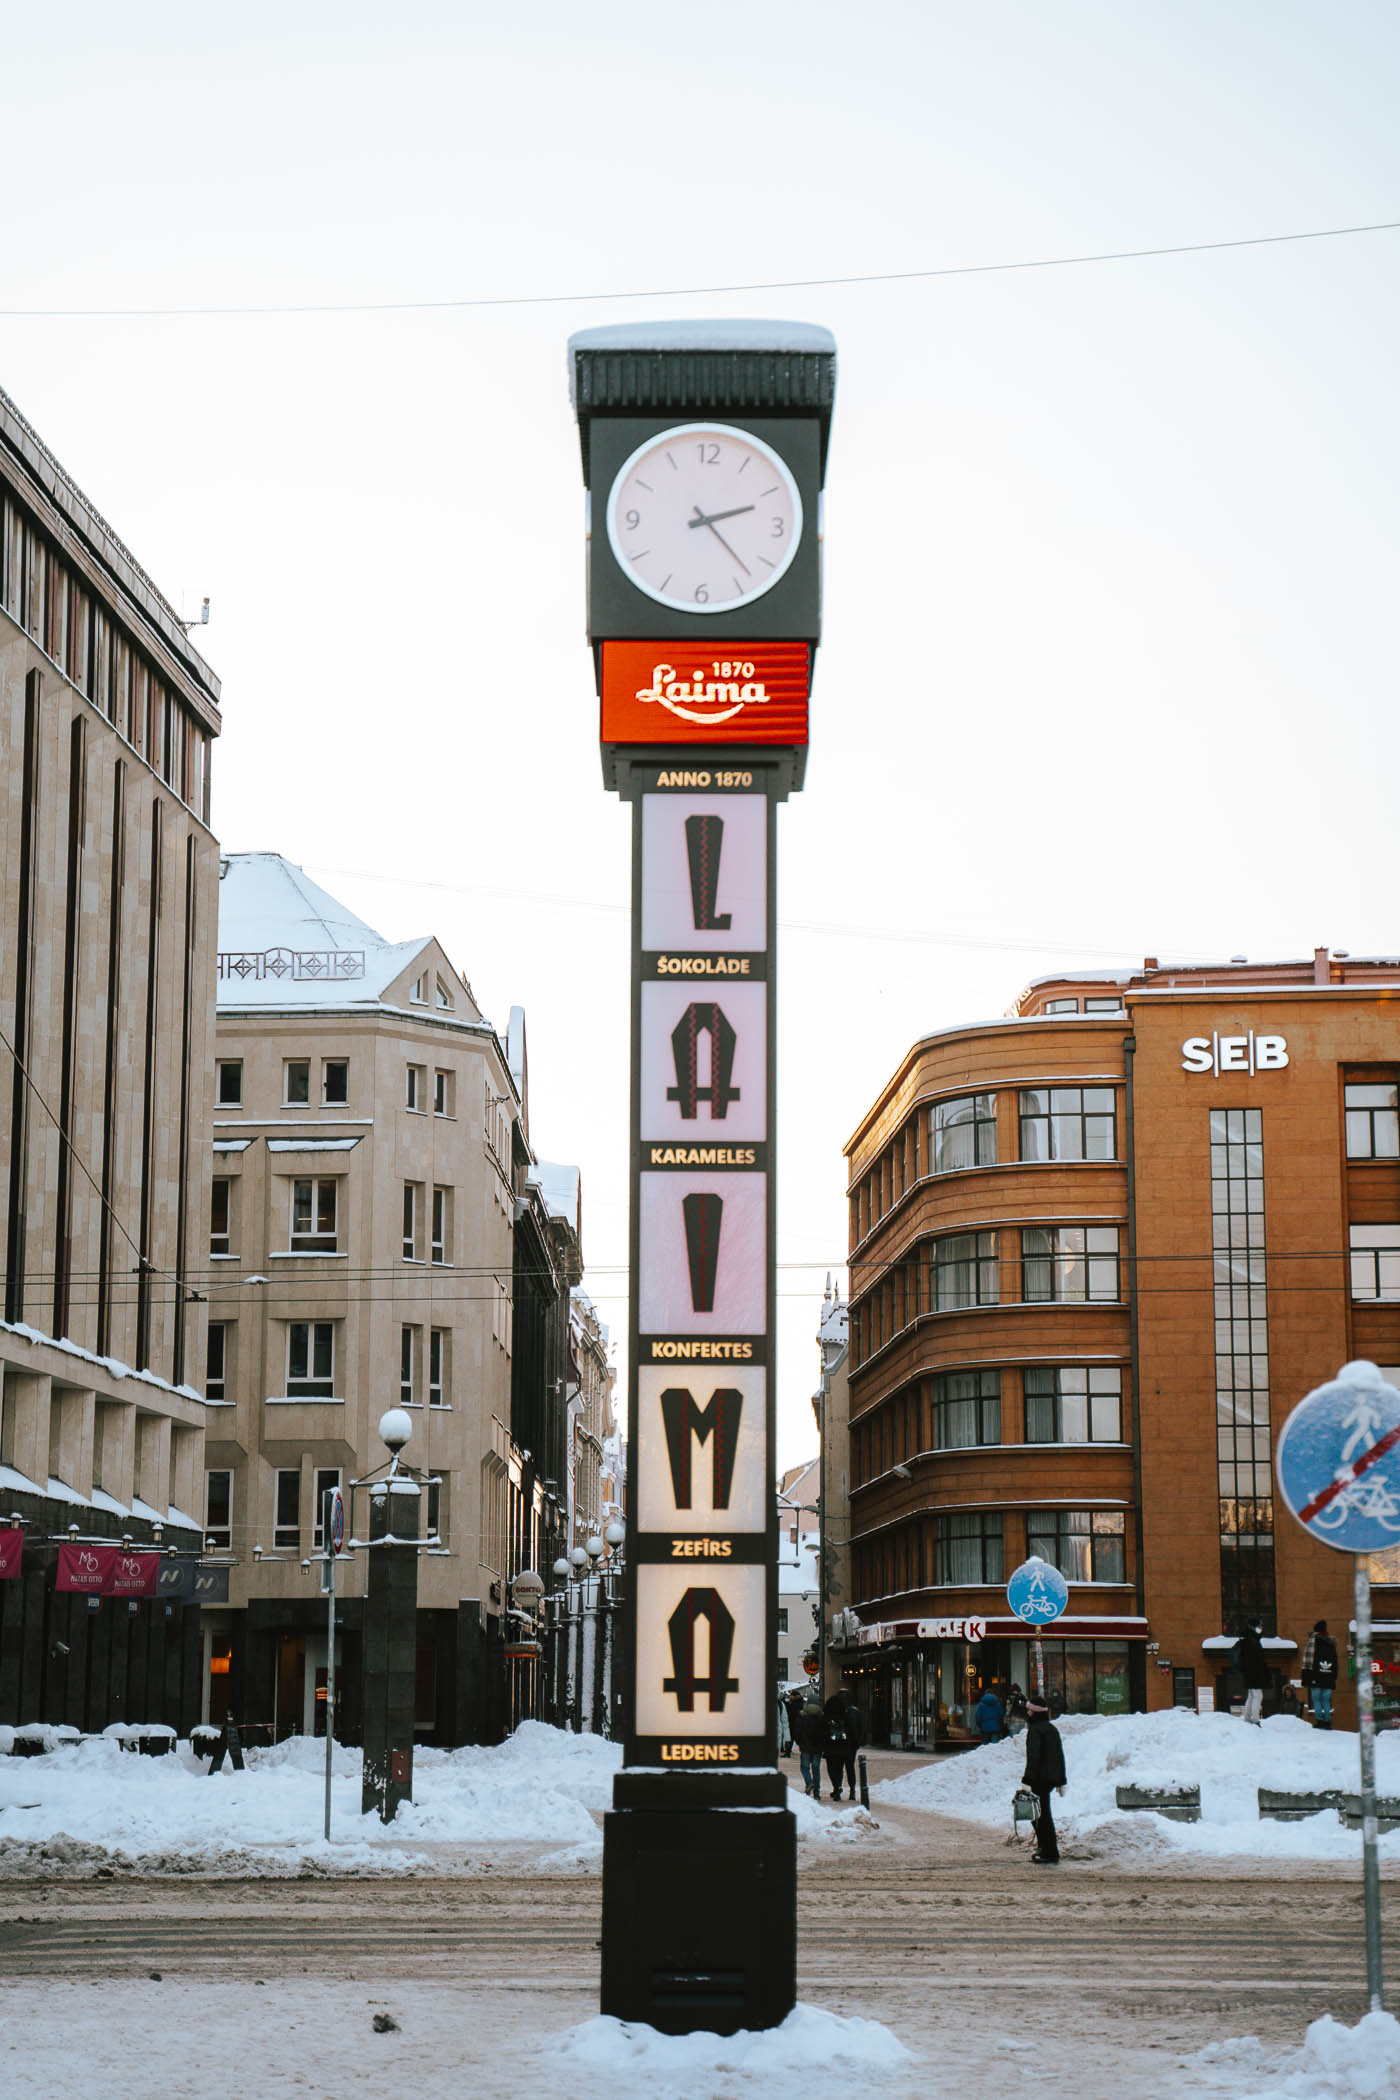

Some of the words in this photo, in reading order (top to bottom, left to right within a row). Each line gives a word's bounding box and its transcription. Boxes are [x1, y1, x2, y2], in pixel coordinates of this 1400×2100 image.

[697, 444, 720, 464] 12
[626, 510, 640, 530] 9
[771, 517, 784, 538] 3
[694, 584, 709, 604] 6
[712, 662, 755, 678] 1870
[635, 664, 771, 724] Laima
[656, 771, 711, 787] ANNO
[714, 771, 752, 787] 1870
[657, 956, 750, 974] ŠOKOLĀDE
[650, 1149, 756, 1164] KARAMELES
[651, 1342, 753, 1358] KONFEKTES
[671, 1539, 732, 1557] ZEFĪRS
[969, 1622, 983, 1641] K
[661, 1744, 739, 1760] LEDENES
